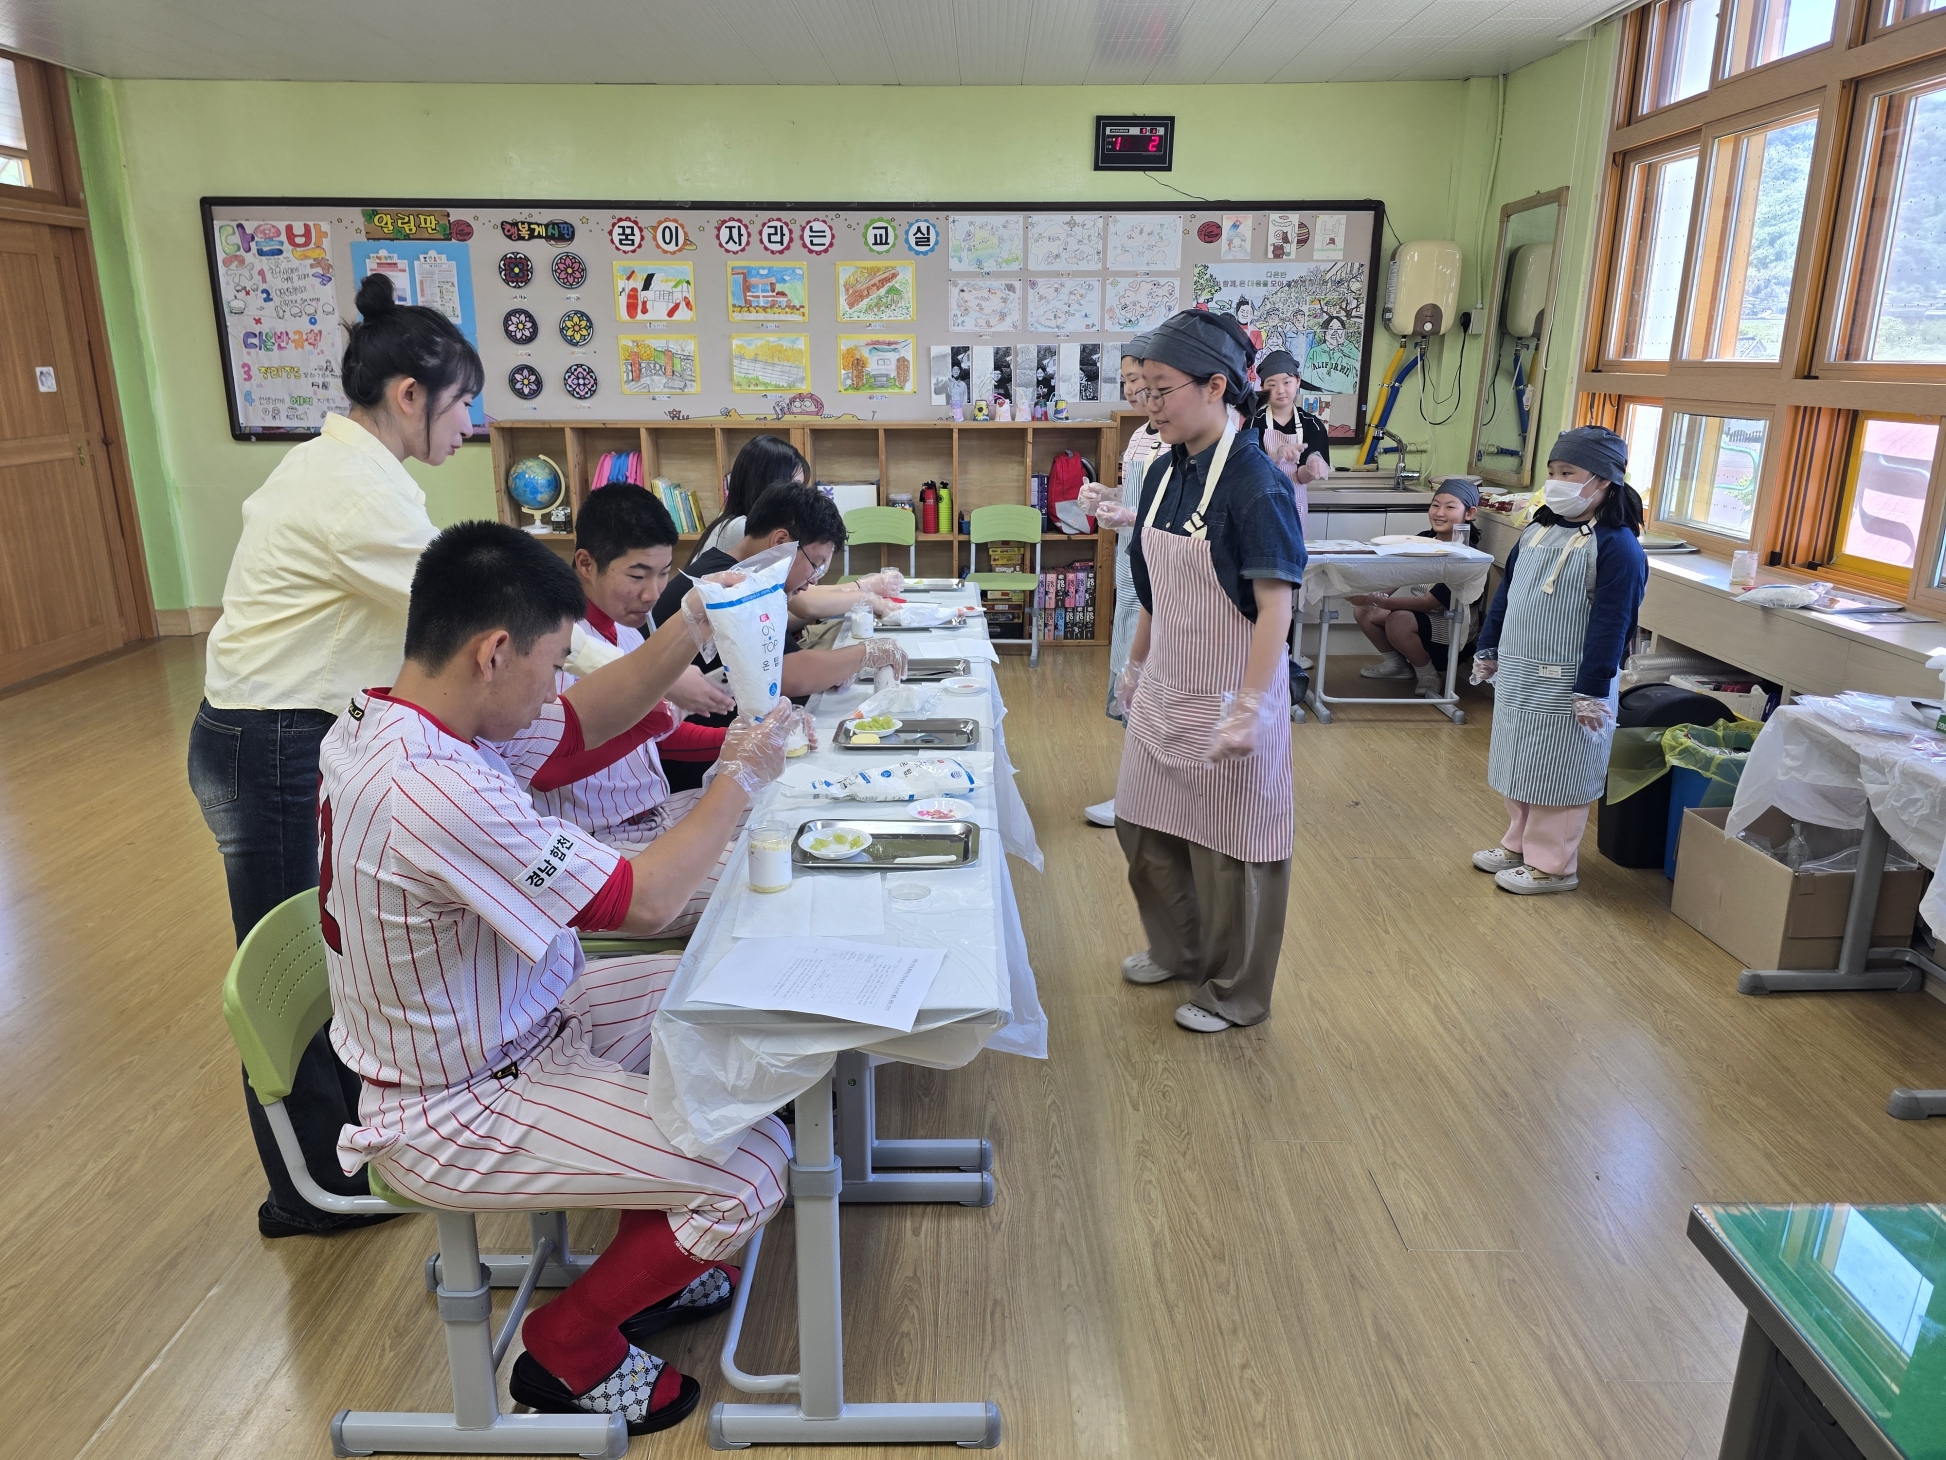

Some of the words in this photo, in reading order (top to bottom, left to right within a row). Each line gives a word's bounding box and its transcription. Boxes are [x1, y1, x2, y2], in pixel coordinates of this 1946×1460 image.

[1115, 137, 1122, 150] 1
[1148, 136, 1159, 151] 2
[374, 213, 439, 234] 알림판
[502, 221, 573, 240] 행복게시판
[218, 222, 329, 261] 다온반
[1270, 280, 1284, 288] 모아
[261, 288, 273, 303] 2
[241, 362, 252, 382] 3
[244, 390, 255, 406] 4
[762, 639, 779, 655] TOP
[525, 859, 557, 887] 경남
[550, 834, 574, 862] 합천
